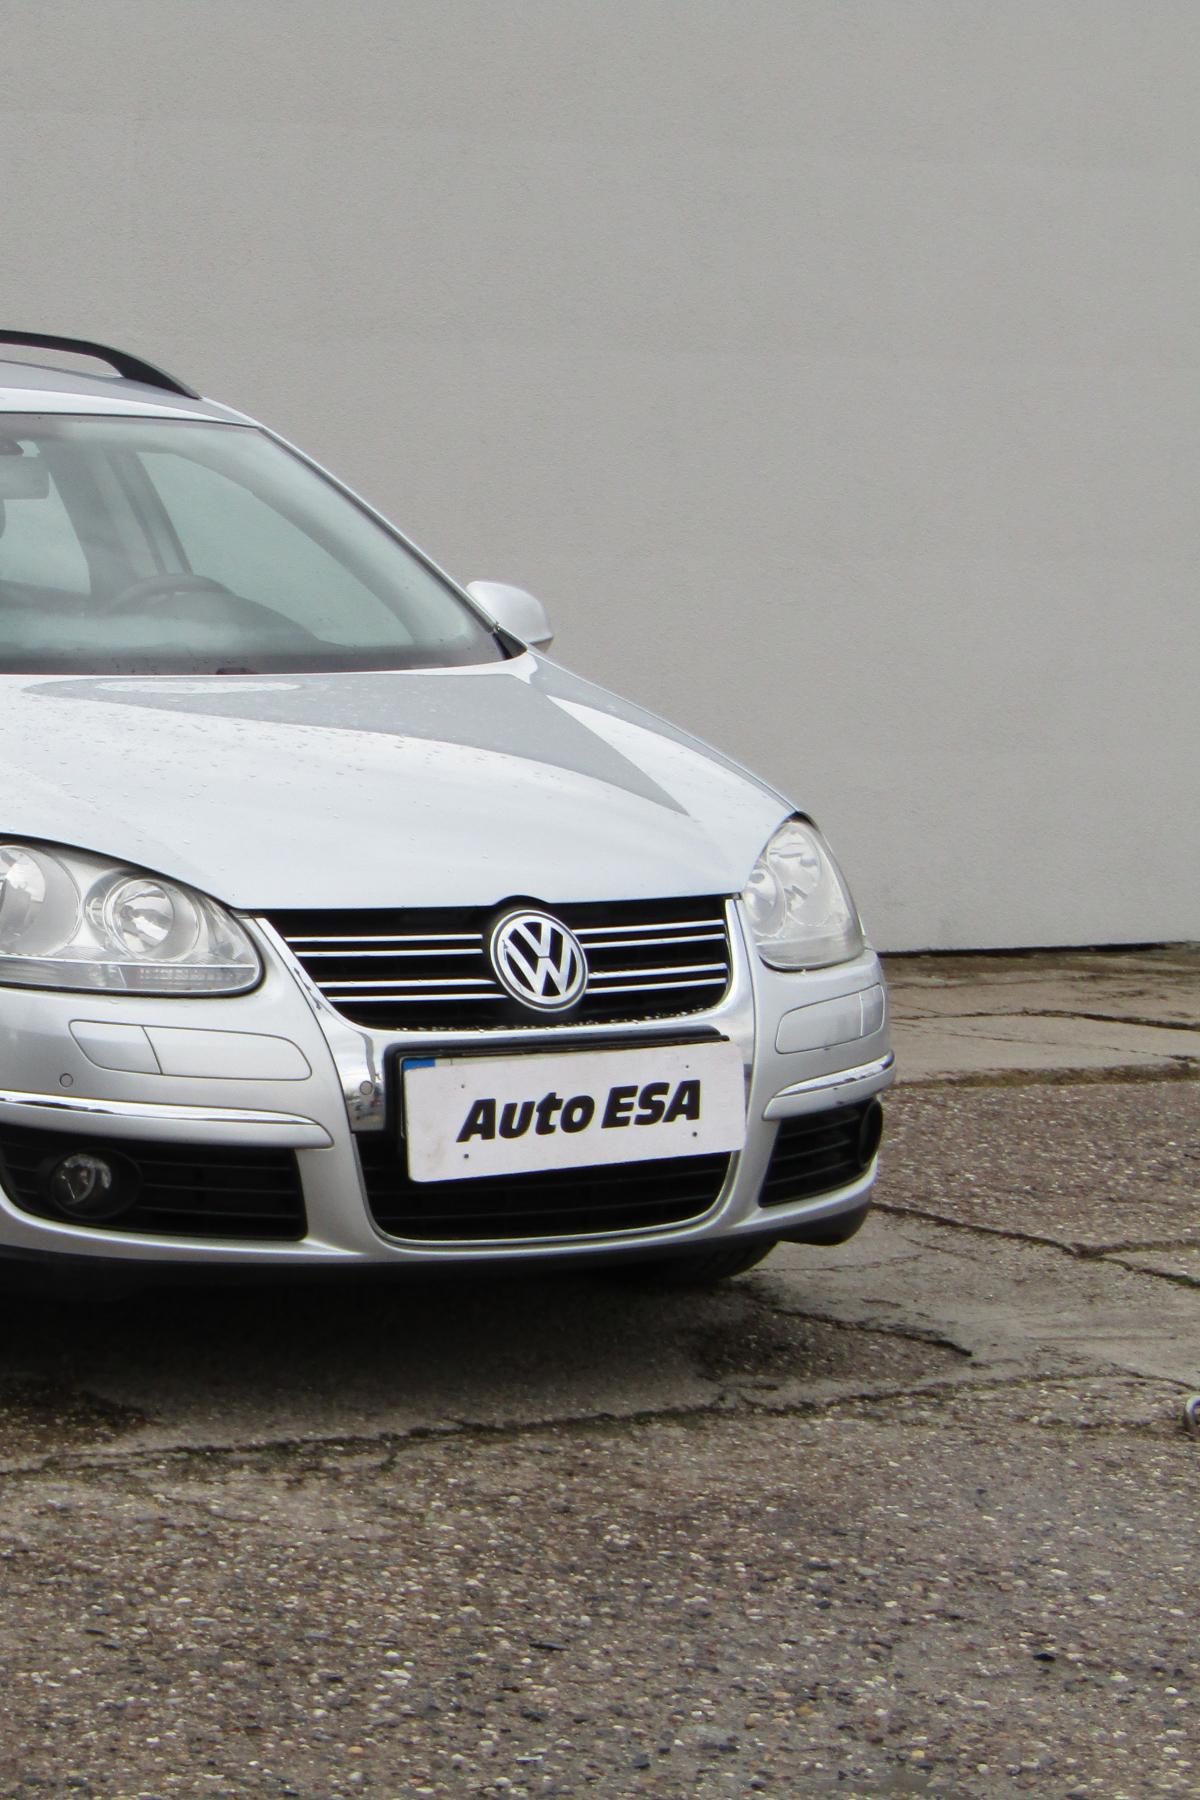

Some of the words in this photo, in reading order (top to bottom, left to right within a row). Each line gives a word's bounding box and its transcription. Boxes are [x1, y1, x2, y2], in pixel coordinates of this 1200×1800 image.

[493, 912, 586, 1008] VW
[456, 1092, 595, 1143] Auto
[601, 1079, 701, 1129] ESA
